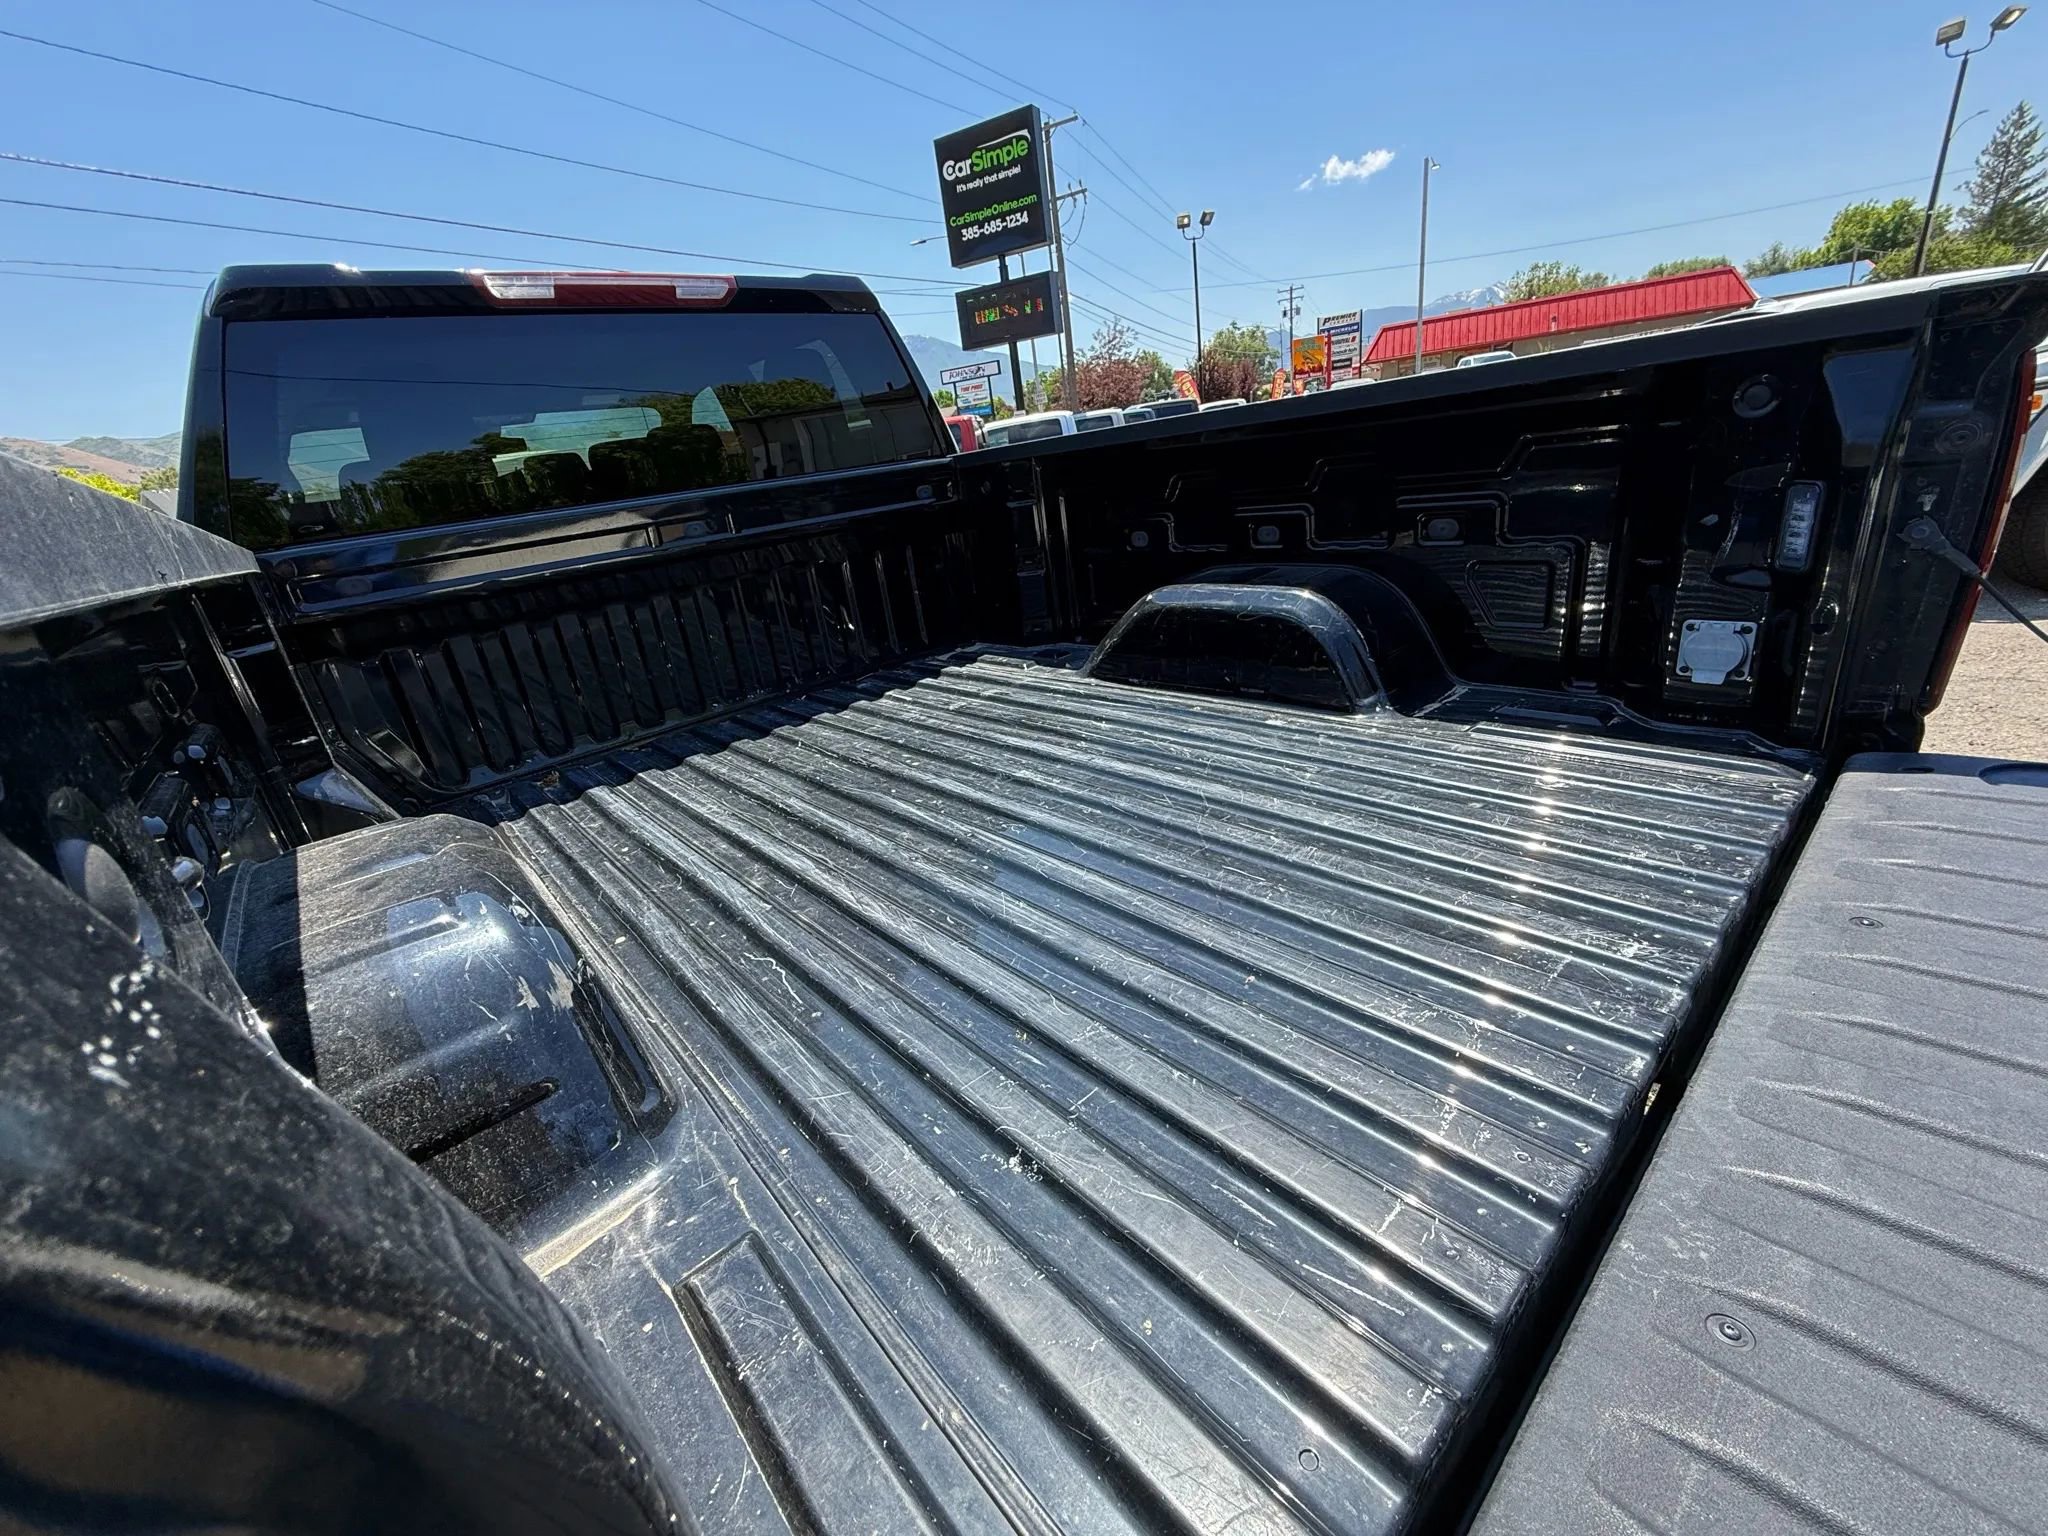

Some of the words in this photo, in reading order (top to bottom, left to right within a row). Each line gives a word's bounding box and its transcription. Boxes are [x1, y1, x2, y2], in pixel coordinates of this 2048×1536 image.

[942, 138, 1029, 181] CarSimple
[956, 182, 966, 193] It's
[966, 177, 984, 190] really
[984, 173, 998, 184] that
[998, 164, 1021, 179] simple!
[949, 194, 1038, 227] CarSimpleOnline.com
[961, 210, 1029, 241] 385-685-1234
[1322, 312, 1357, 326] PREMIER
